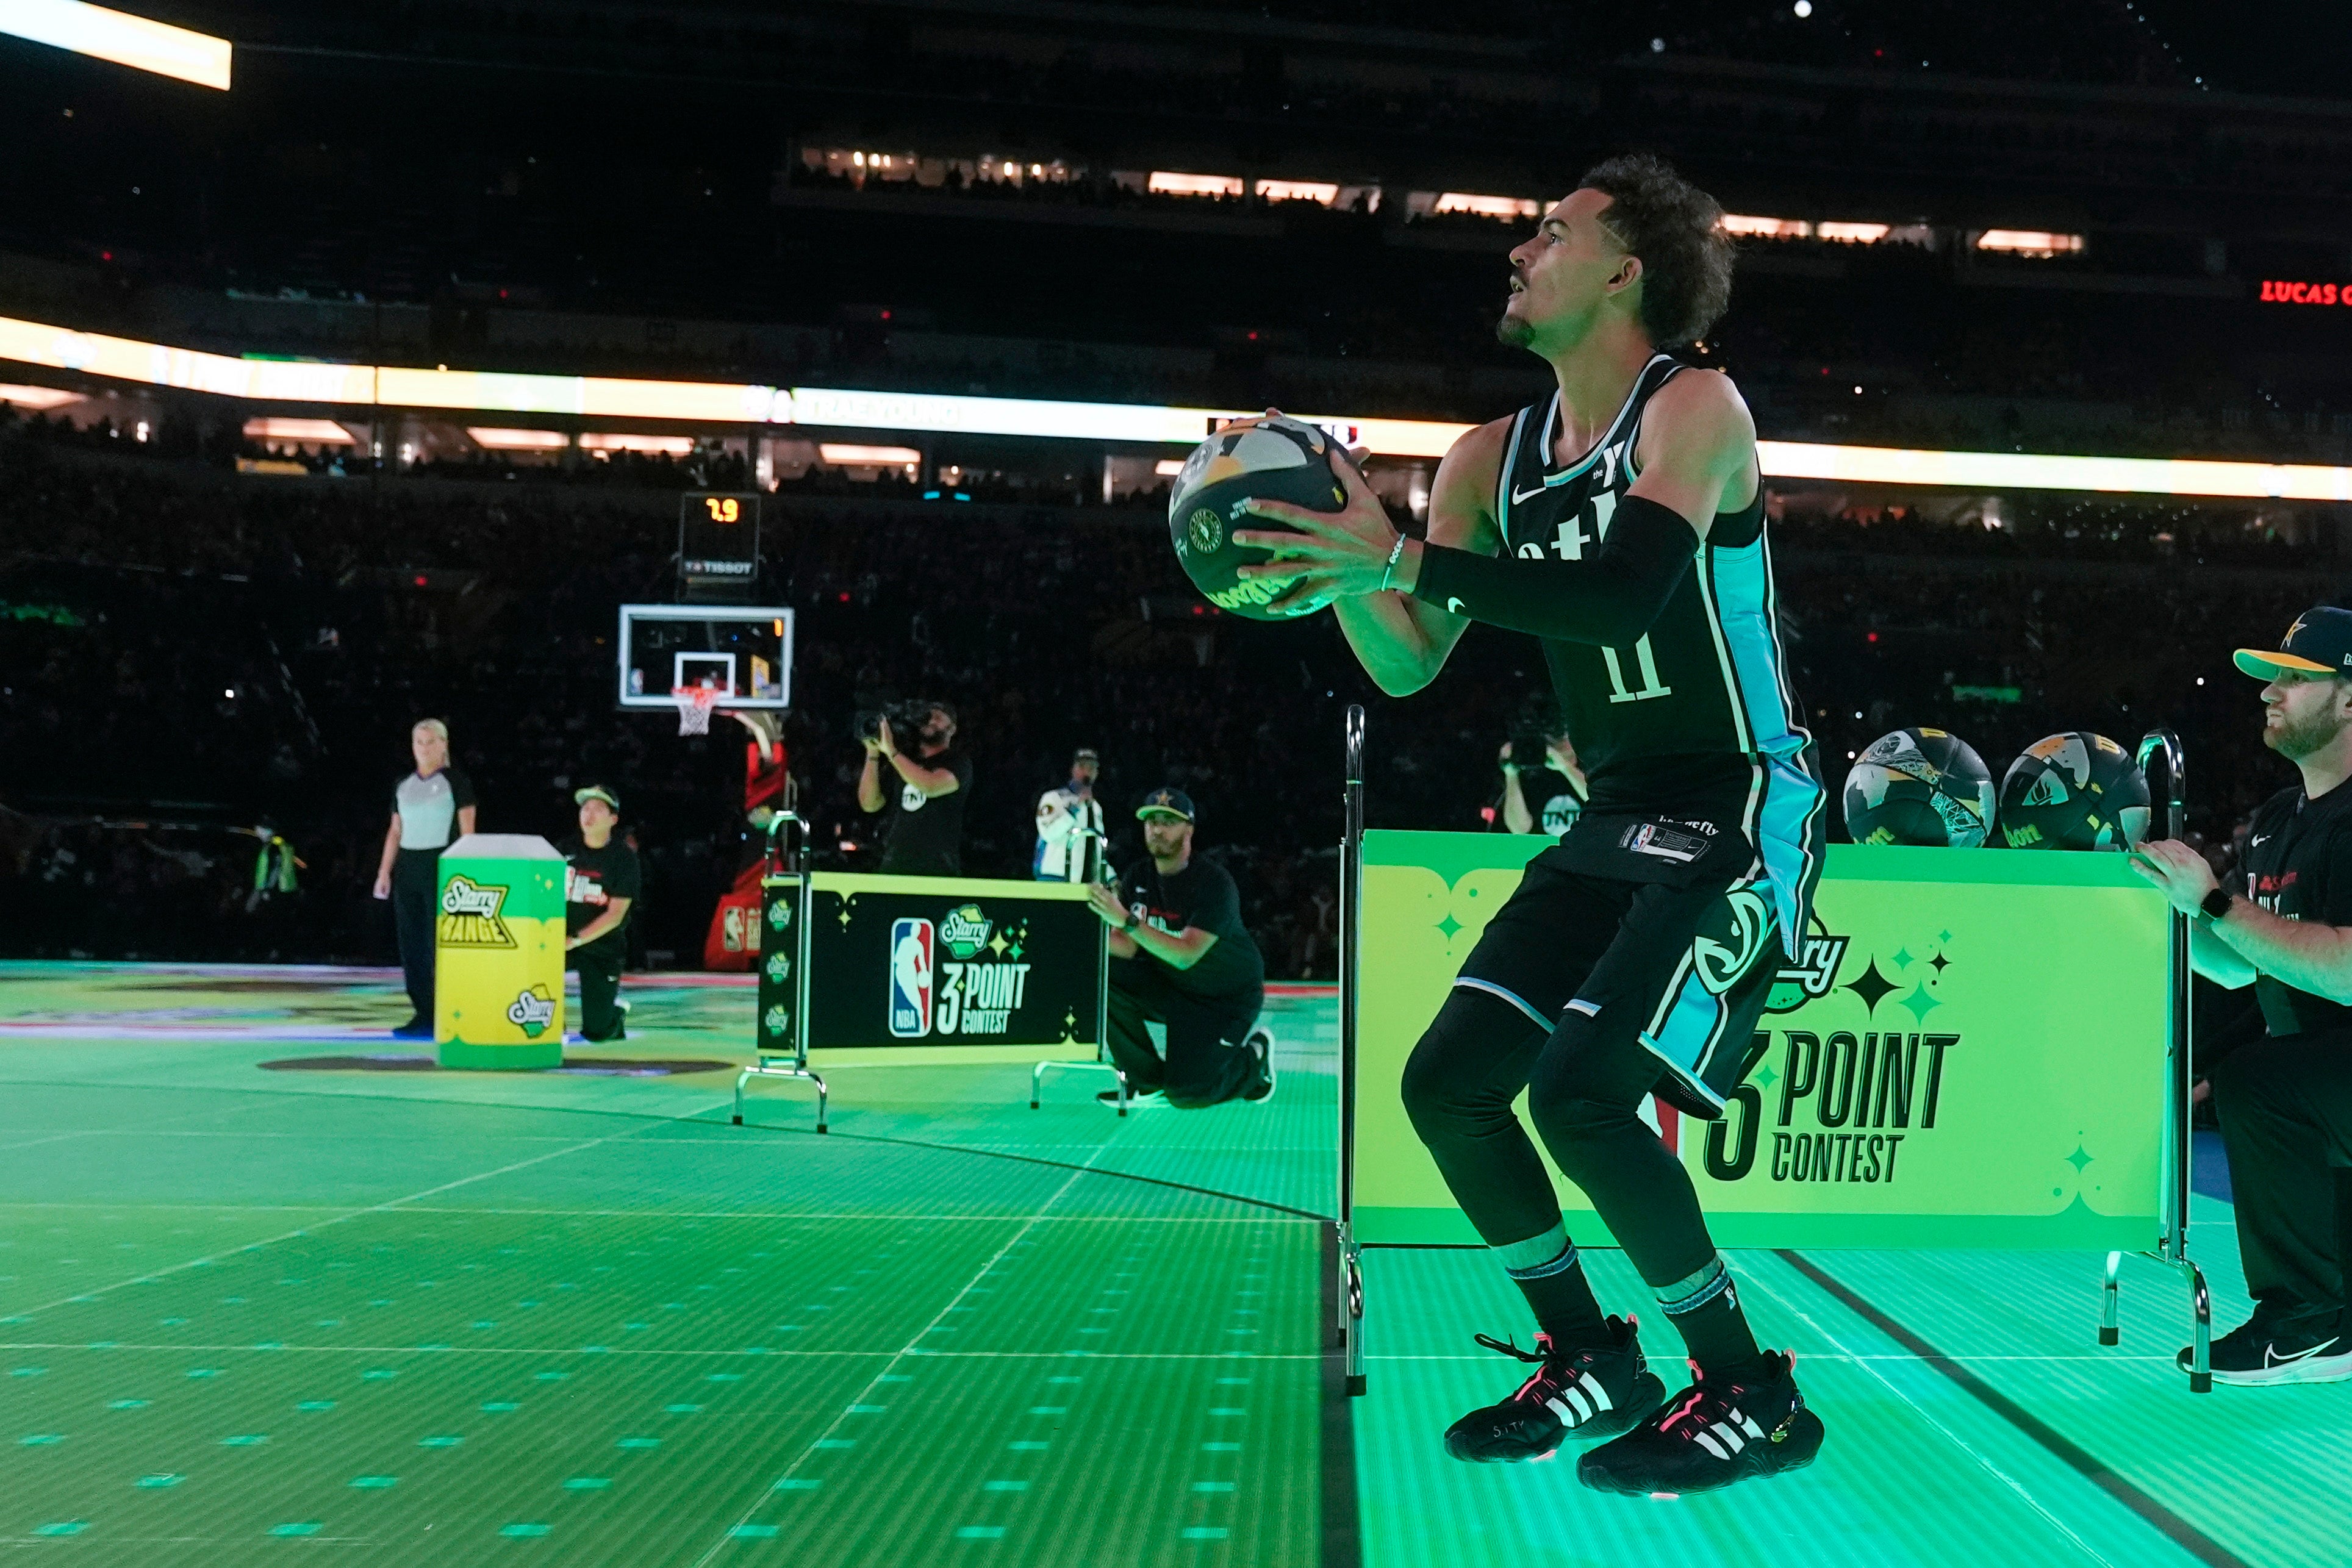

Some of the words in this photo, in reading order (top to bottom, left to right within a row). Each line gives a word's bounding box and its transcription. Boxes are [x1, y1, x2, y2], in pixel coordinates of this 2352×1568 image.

[2260, 280, 2338, 306] LUCAS
[805, 395, 869, 420] TRAE
[871, 398, 959, 426] YOUNG
[1593, 469, 1604, 480] the
[703, 560, 752, 575] TISSOT
[1543, 809, 1580, 826] TNT
[442, 881, 500, 918] Starry
[440, 915, 507, 943] RANGE
[941, 912, 992, 948] Starry
[508, 990, 555, 1028] Starry
[937, 962, 963, 1034] 3
[964, 963, 1031, 1009] POINT
[895, 1008, 917, 1030] NBA
[961, 1009, 1011, 1034] CONTEST
[1779, 1029, 1961, 1129] POINT
[1771, 1132, 1906, 1183] CONTEST
